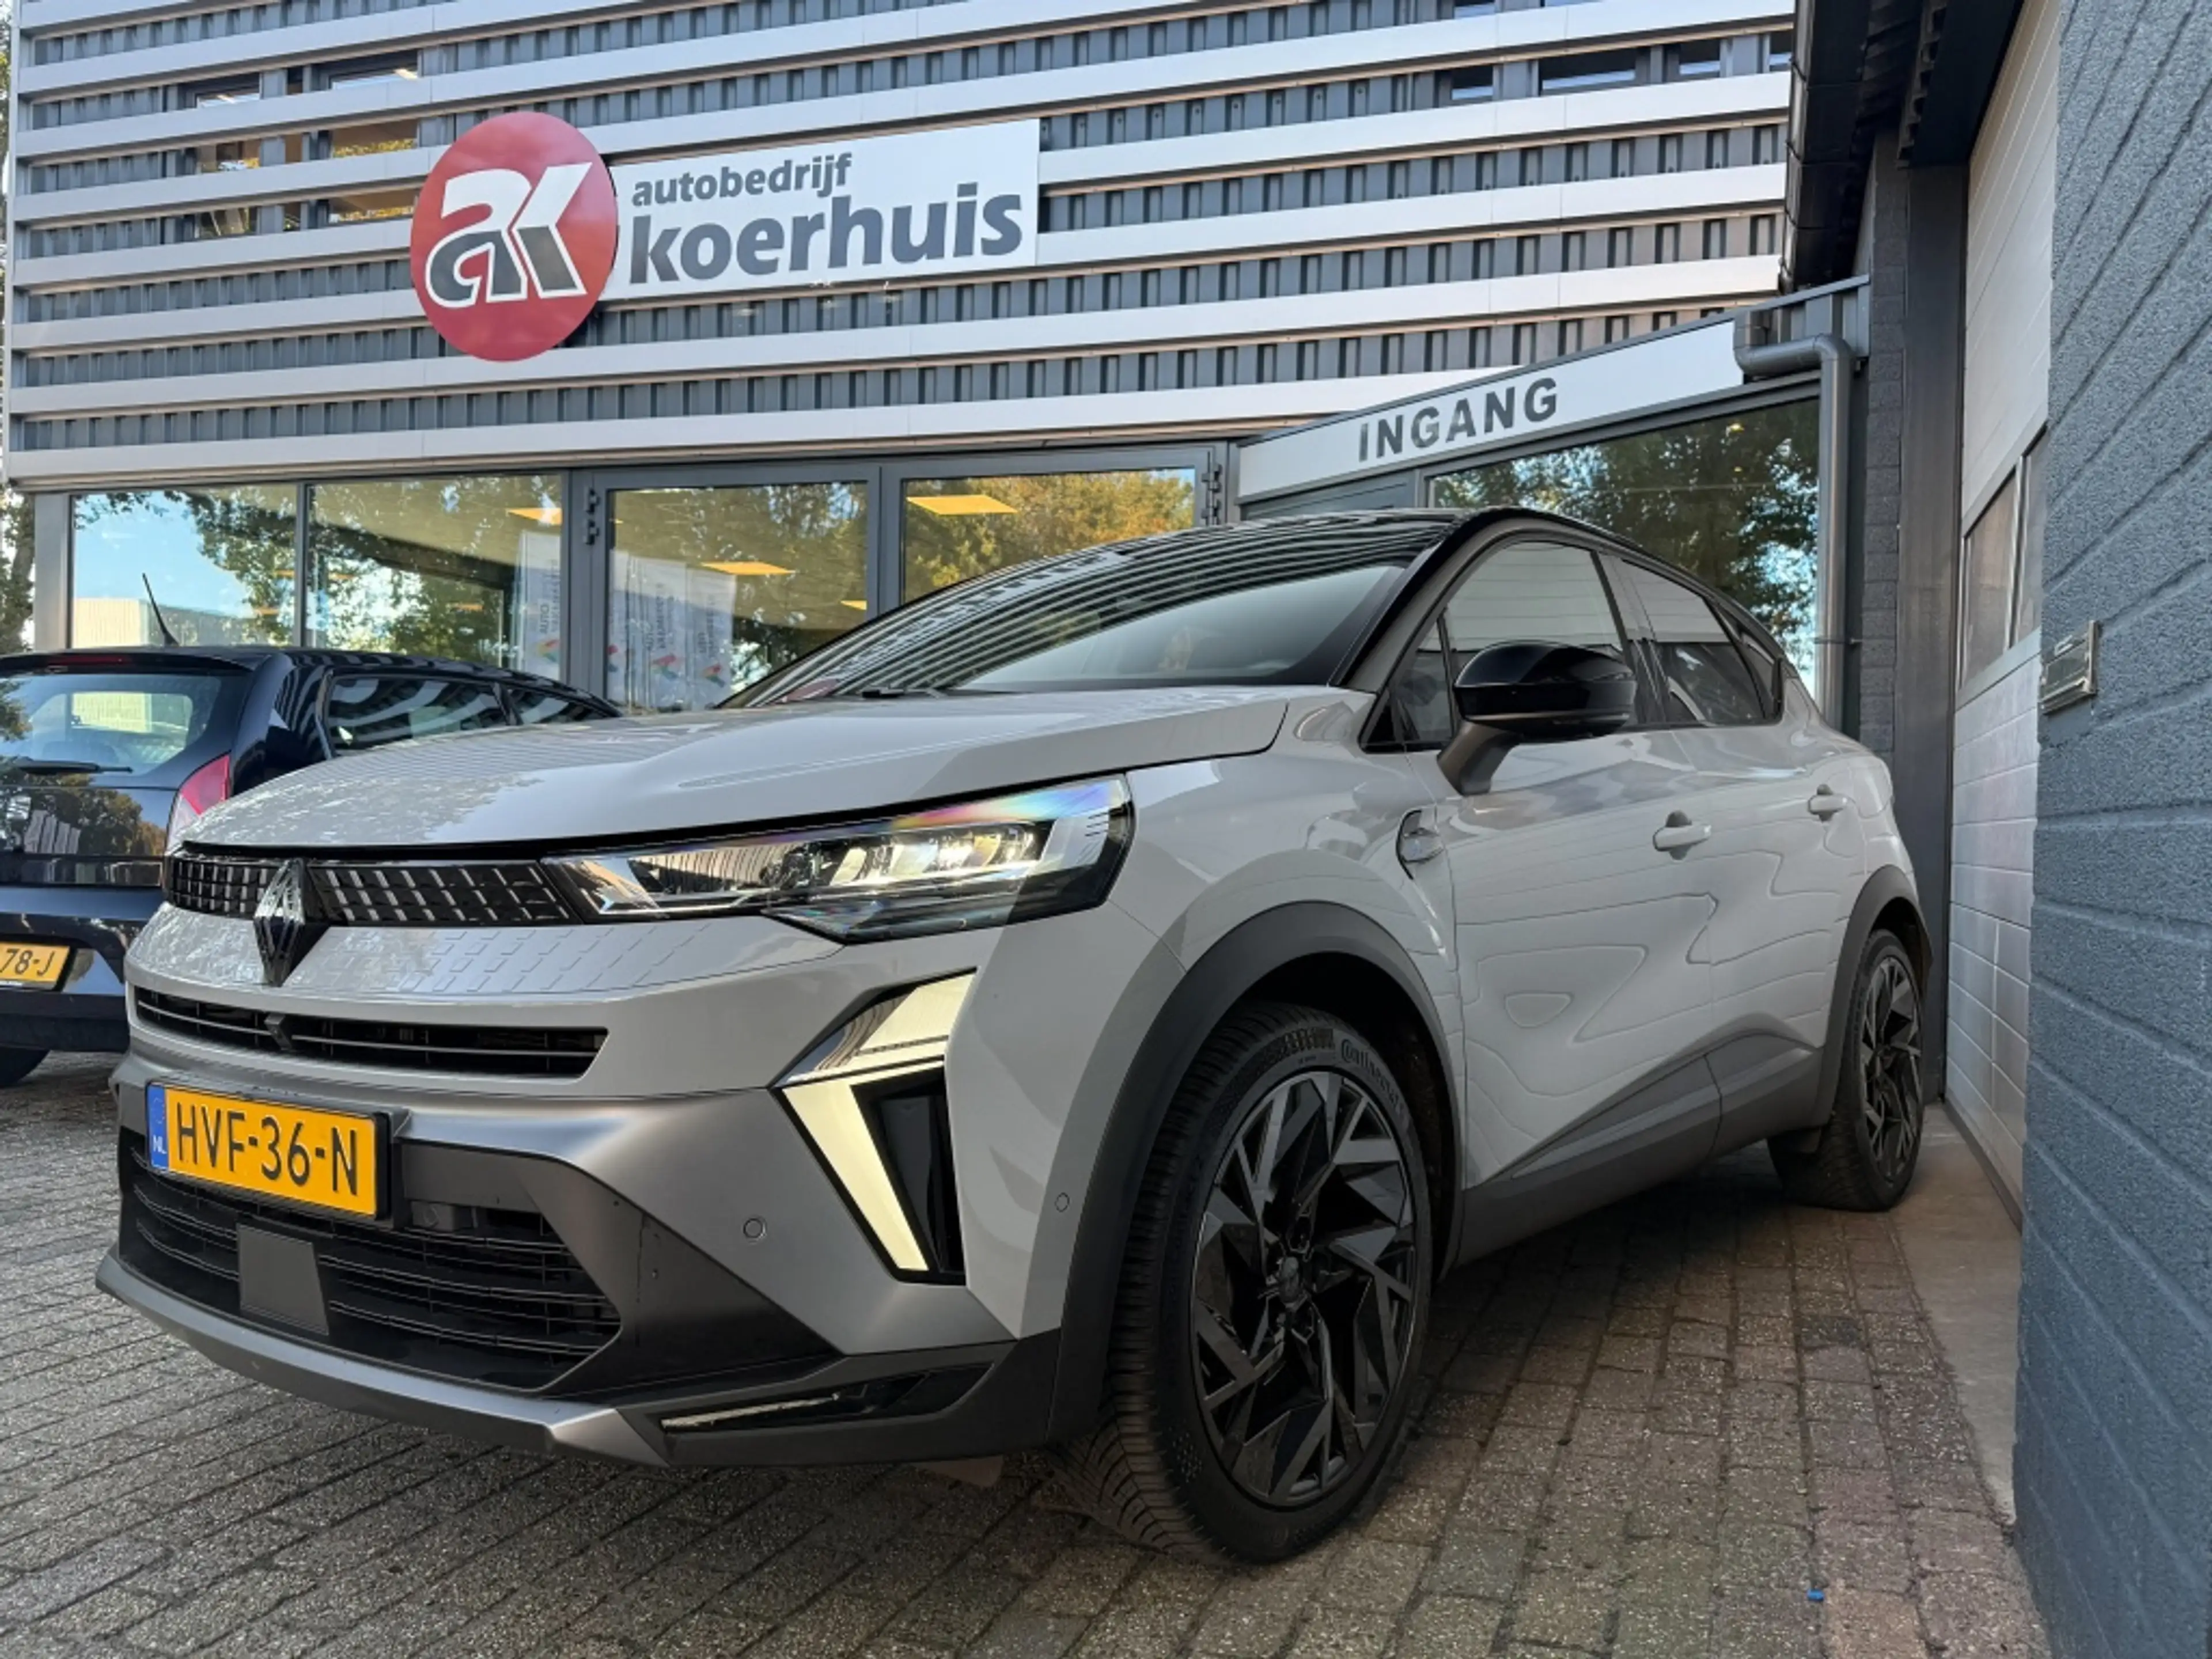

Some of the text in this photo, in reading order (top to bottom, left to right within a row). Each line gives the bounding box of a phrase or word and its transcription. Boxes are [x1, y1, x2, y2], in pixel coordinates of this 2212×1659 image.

[631, 152, 853, 207] autobedrijf
[630, 182, 1022, 284] koerhuis
[1359, 377, 1557, 461] INGANG
[153, 1135, 167, 1154] NL
[176, 1101, 358, 1196] HVF-36-N
